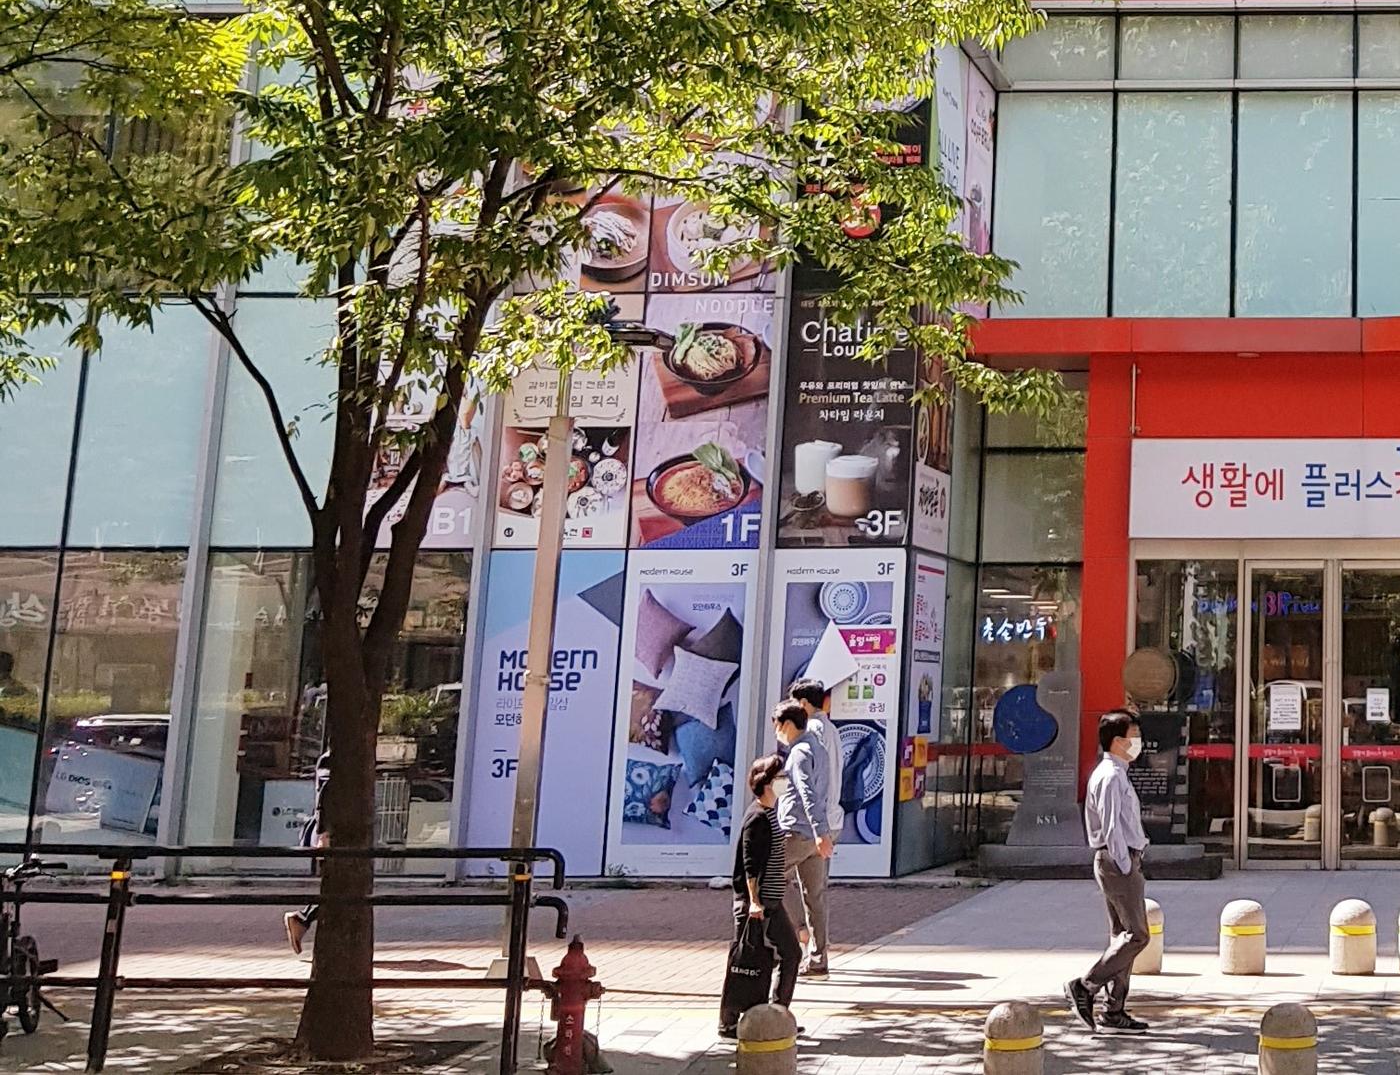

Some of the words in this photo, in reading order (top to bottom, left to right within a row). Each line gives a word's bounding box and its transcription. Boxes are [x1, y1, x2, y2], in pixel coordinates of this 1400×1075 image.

[650, 272, 729, 287] DIMSUM
[695, 299, 774, 314] NOODLE
[524, 395, 583, 408] 단체임
[799, 392, 850, 404] Premium
[852, 392, 873, 404] Tea
[876, 392, 905, 404] Latte
[1180, 462, 1285, 508] 생활에
[432, 506, 473, 536] B1
[720, 514, 761, 543] 1F
[867, 511, 901, 536] 3F
[731, 563, 749, 576] 3F
[877, 562, 895, 576] 3F
[500, 650, 598, 669] Moern
[497, 672, 582, 691] Hose
[491, 758, 519, 778] 3F
[1036, 814, 1058, 825] KSA
